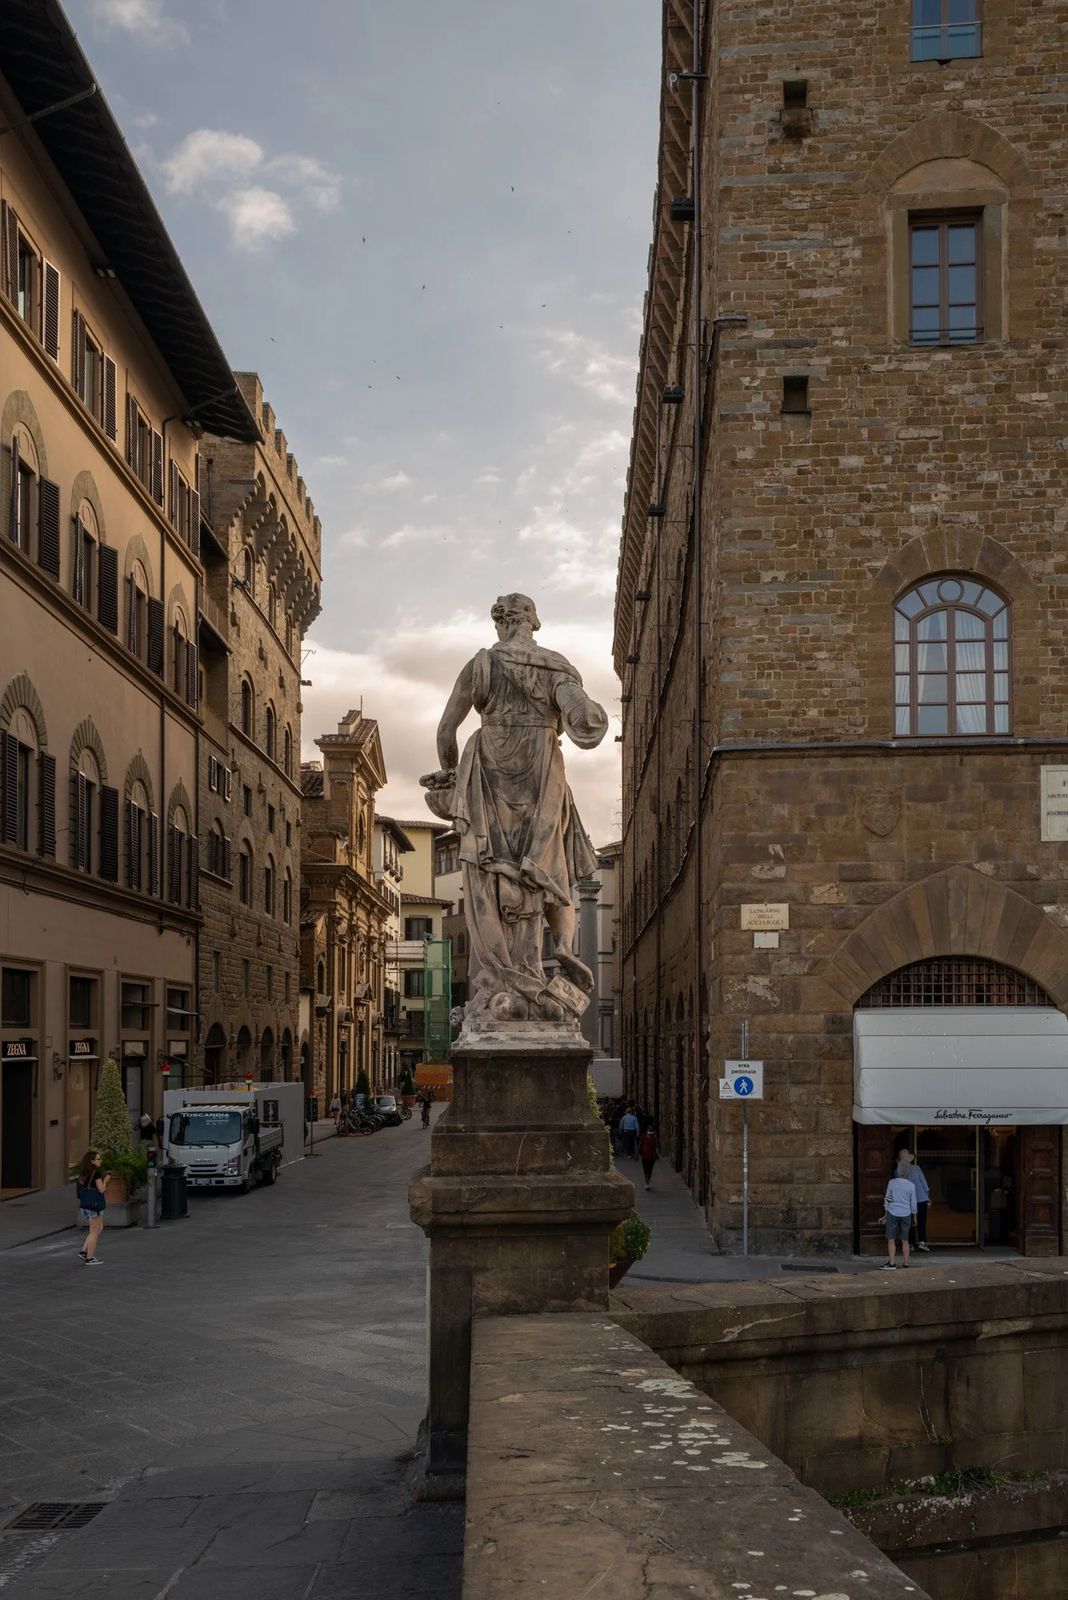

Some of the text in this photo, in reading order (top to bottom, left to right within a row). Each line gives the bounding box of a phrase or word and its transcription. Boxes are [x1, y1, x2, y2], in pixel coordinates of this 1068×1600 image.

[6, 1043, 27, 1056] ZEGNA
[74, 1041, 90, 1054] ZEGNA
[934, 1108, 1013, 1124] Salvatore Ferragamo
